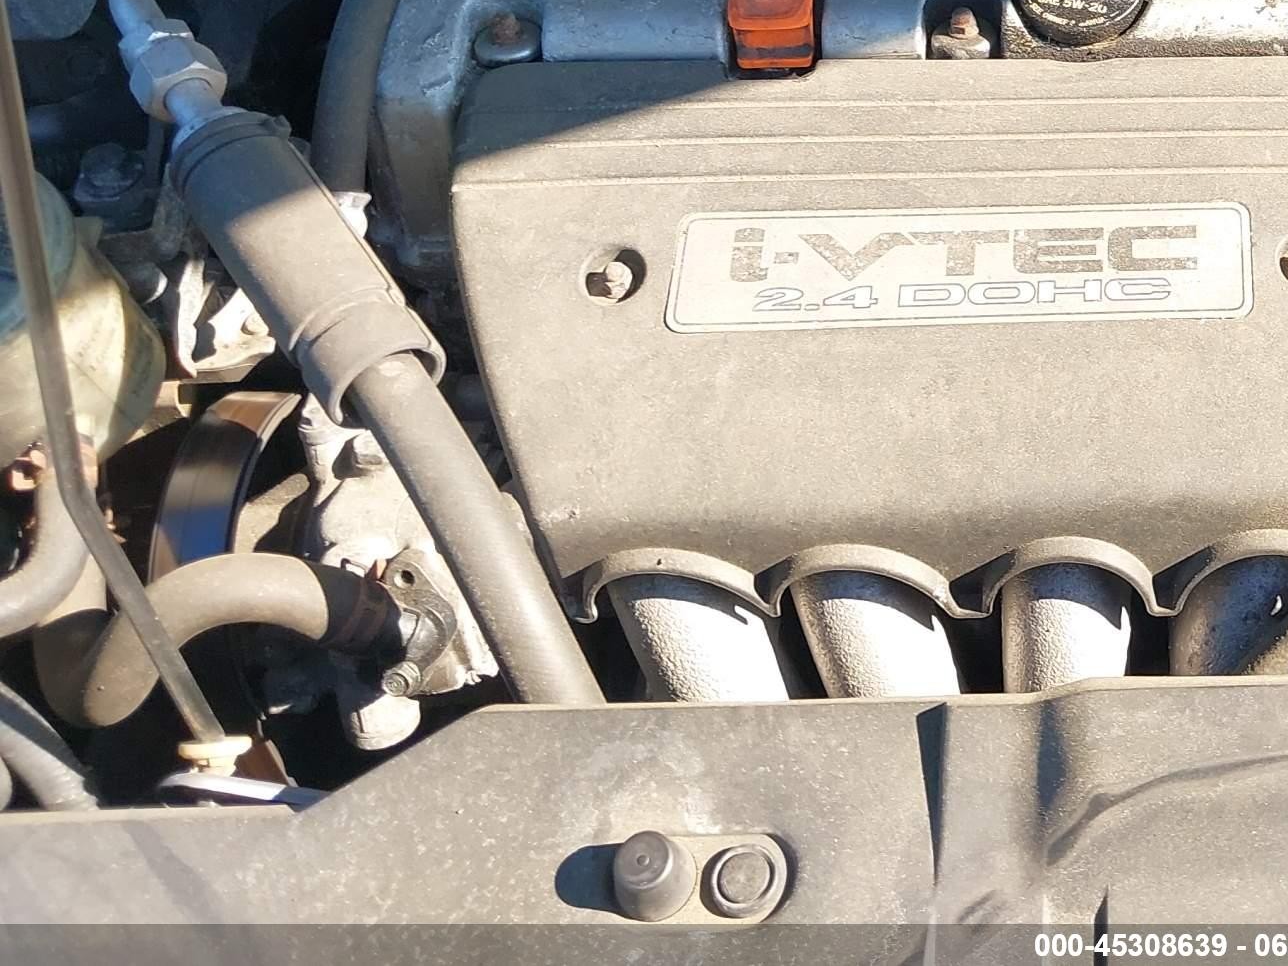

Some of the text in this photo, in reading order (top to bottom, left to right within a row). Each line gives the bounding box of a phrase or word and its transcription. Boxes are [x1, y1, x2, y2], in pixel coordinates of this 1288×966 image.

[729, 224, 1199, 283] i-VTEC
[752, 277, 1171, 312] 2.4 DOHC
